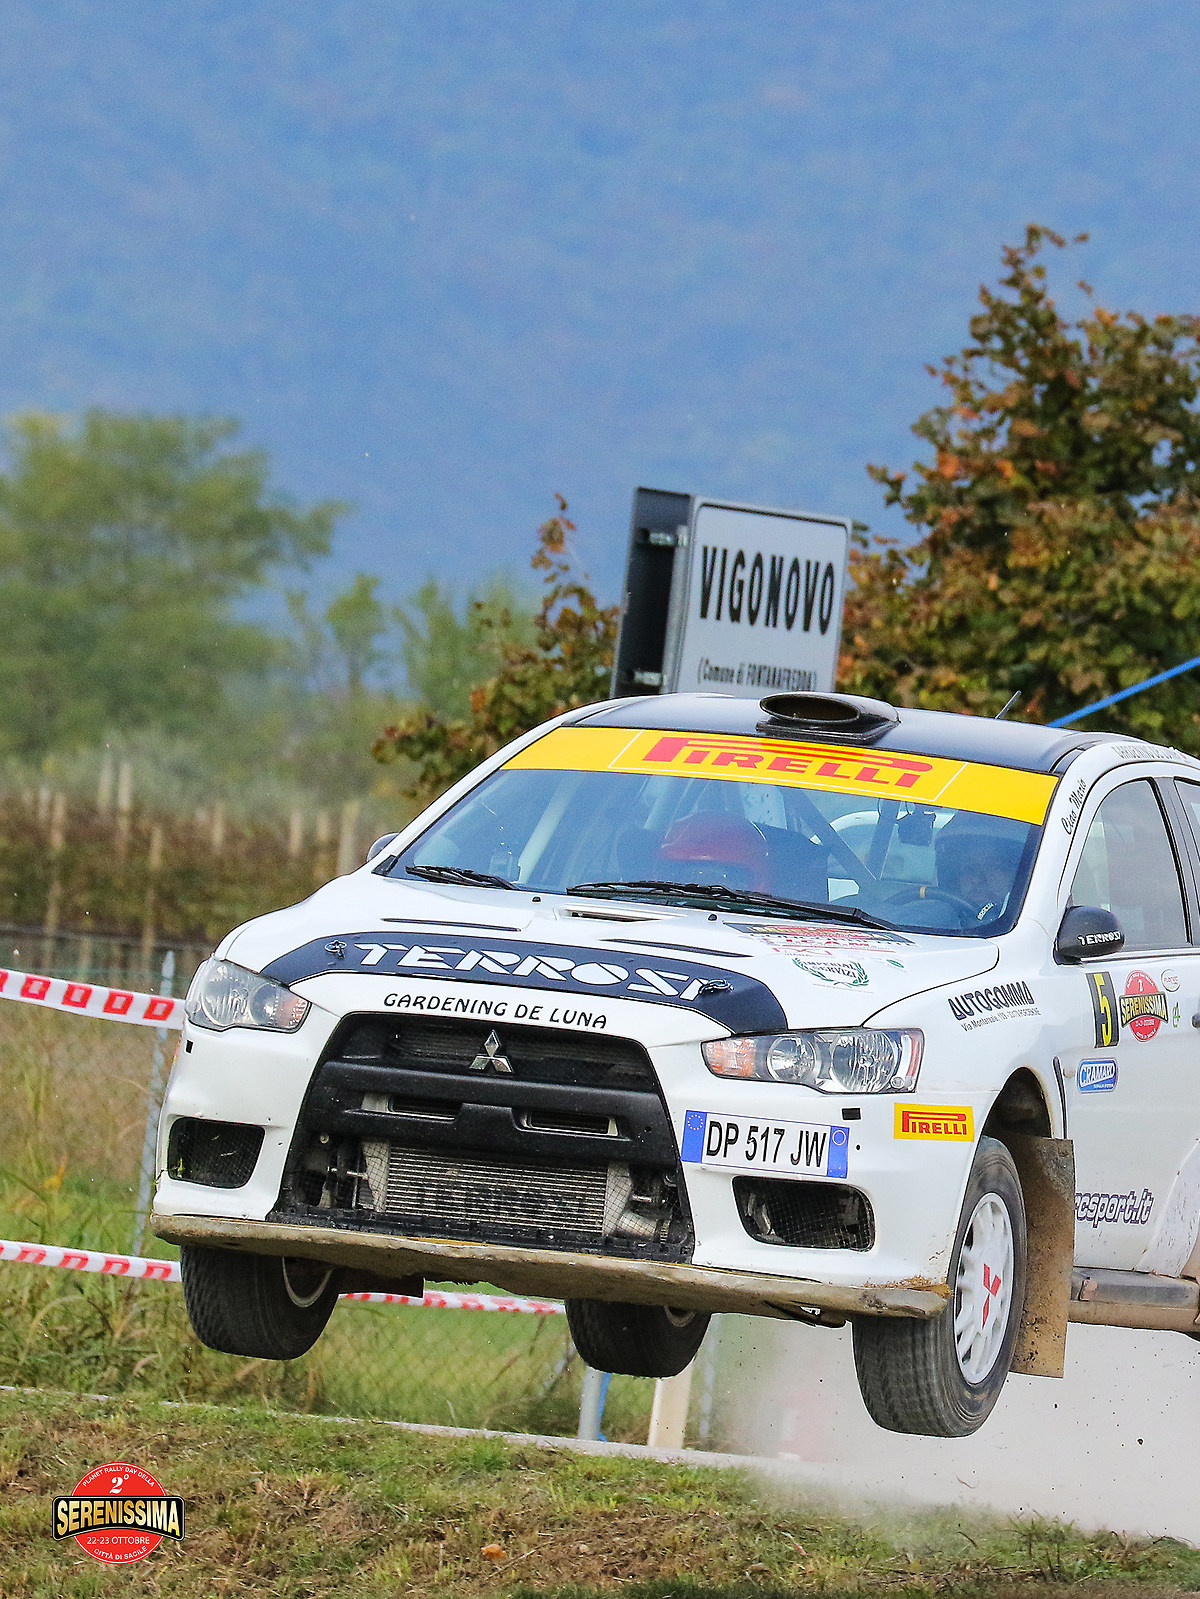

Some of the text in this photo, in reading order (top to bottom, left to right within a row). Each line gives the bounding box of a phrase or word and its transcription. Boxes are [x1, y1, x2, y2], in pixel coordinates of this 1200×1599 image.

[700, 545, 834, 636] VIGONOVO
[642, 736, 933, 788] PIRELLI
[354, 943, 713, 1002] TERROSI
[383, 992, 607, 1030] GARDENING DE LUNA
[948, 980, 1035, 1021] AUTOGOMMA
[1093, 973, 1112, 1047] 5
[1120, 995, 1168, 1025] SERENISSIMA
[1079, 1063, 1115, 1088] CRAMARO
[706, 1120, 828, 1168] DP 517 JW
[901, 1110, 968, 1136] PIRELLI
